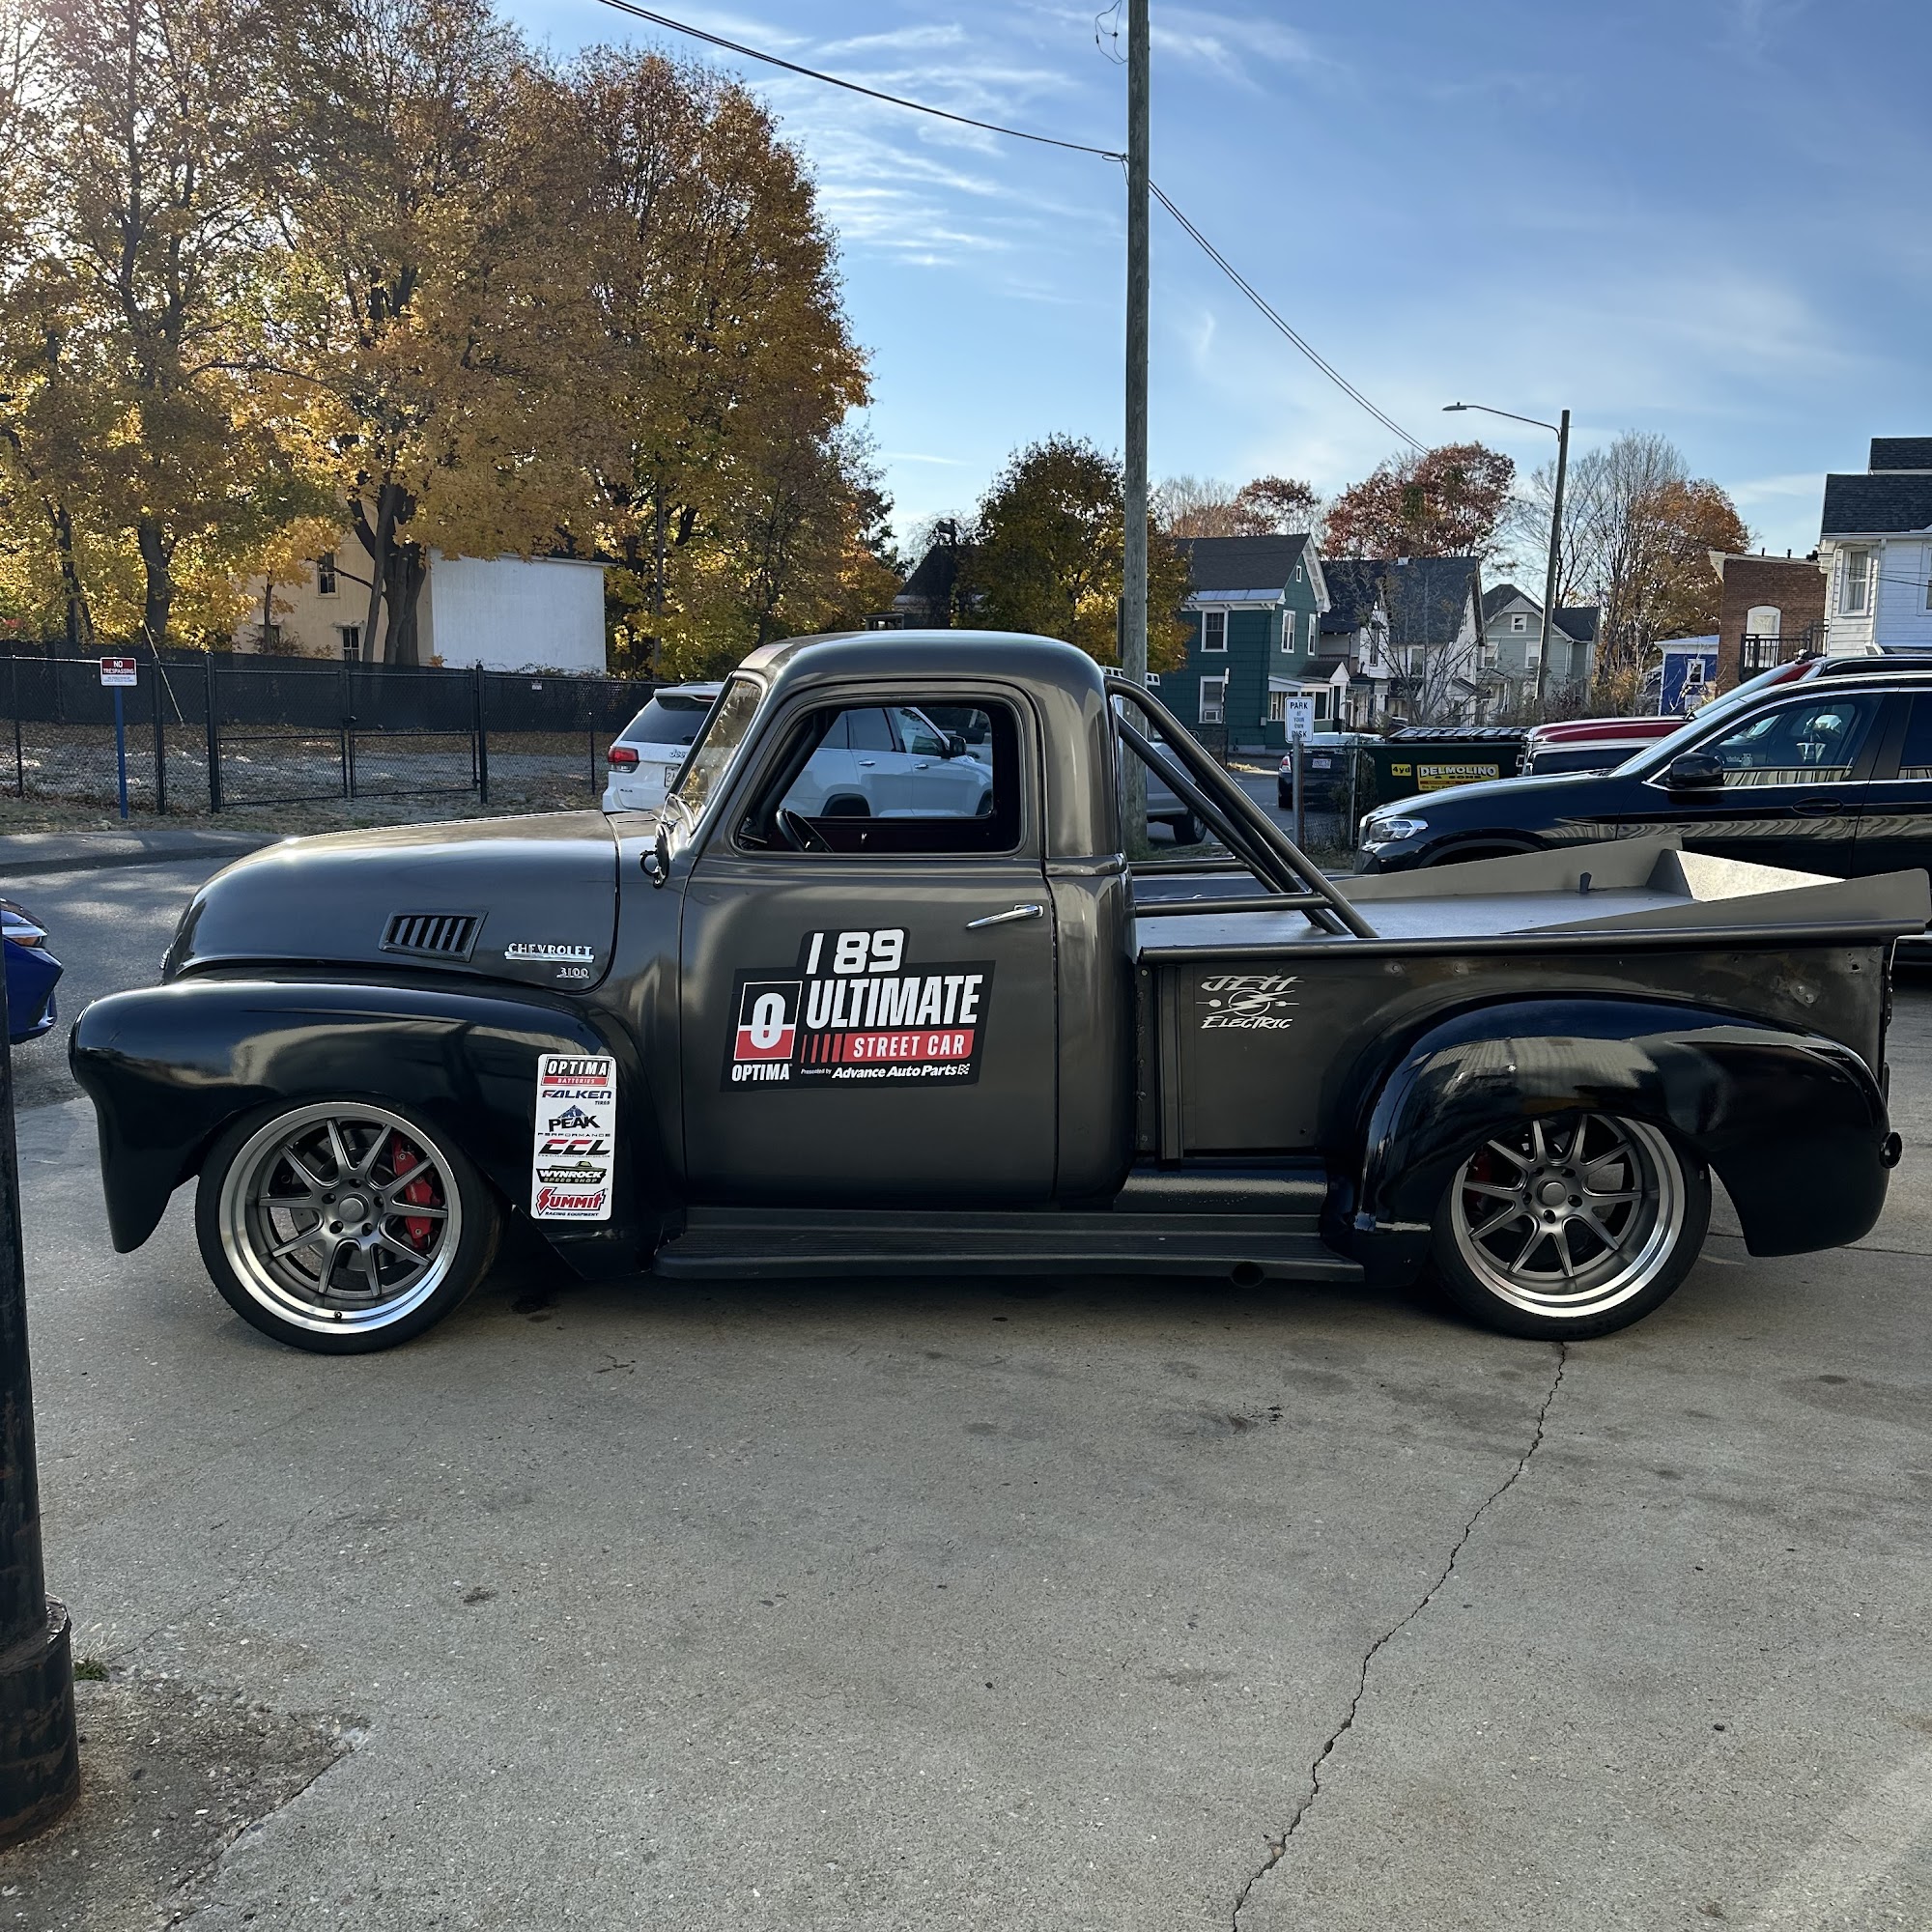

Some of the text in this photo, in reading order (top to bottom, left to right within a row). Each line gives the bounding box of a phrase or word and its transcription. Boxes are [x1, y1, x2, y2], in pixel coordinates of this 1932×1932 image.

[1420, 766, 1497, 777] DELMOLINO
[508, 943, 592, 956] CHEVROLET
[559, 967, 589, 977] 3100
[807, 975, 983, 1029] ULTIMATE
[853, 1035, 965, 1058] STREET CAR
[548, 1061, 607, 1076] OPTIMA
[731, 1063, 790, 1082] OPTIMA
[832, 1066, 886, 1079] Advance
[886, 1065, 921, 1077] Auto
[921, 1064, 957, 1076] Parts
[549, 1115, 601, 1132] PEAK
[539, 1170, 604, 1179] WYNROCK
